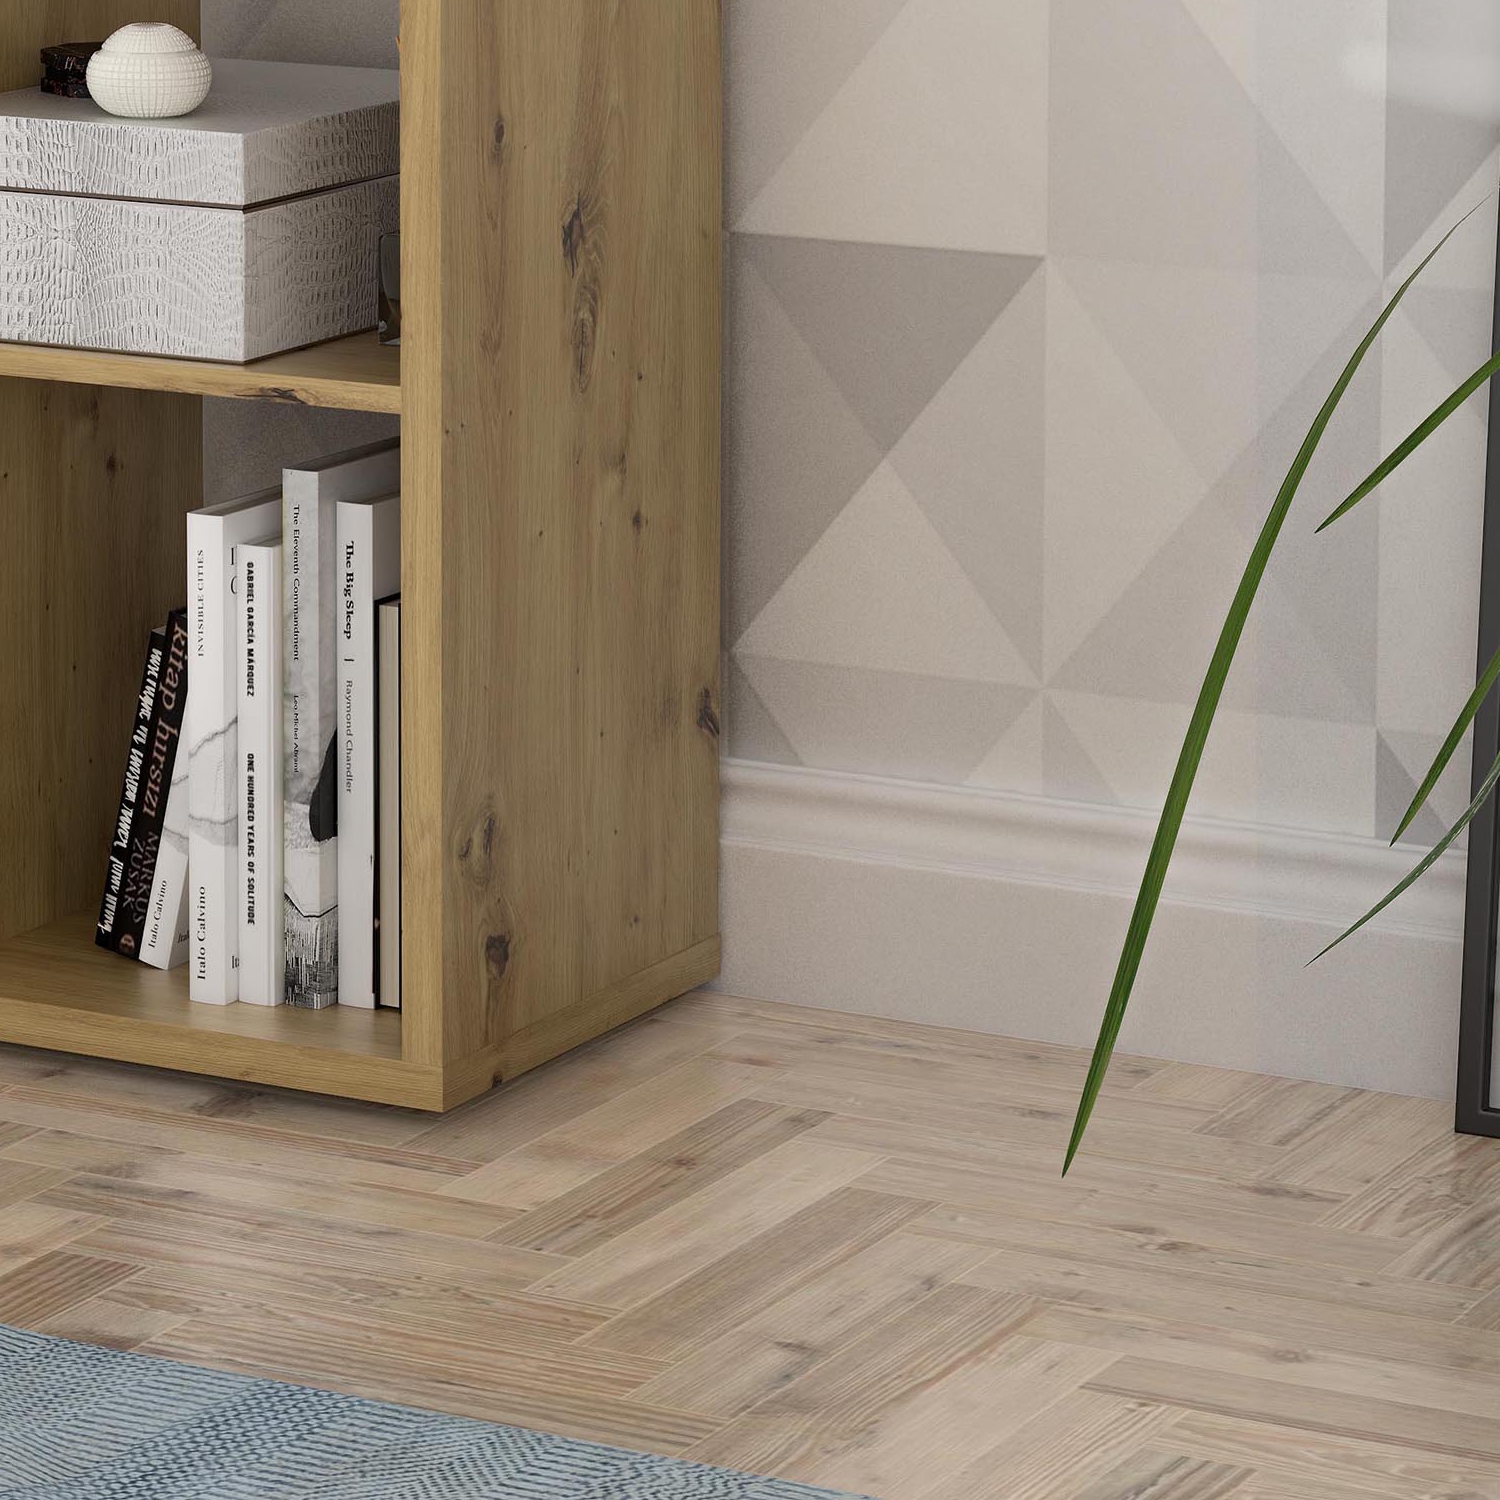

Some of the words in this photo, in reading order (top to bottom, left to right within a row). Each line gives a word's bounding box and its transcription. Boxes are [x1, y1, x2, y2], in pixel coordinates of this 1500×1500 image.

[293, 503, 301, 526] The
[293, 528, 301, 575] Eleventh
[345, 540, 355, 569] The
[246, 561, 255, 605] GABRIEL
[343, 571, 355, 598] Big
[197, 594, 205, 657] INVISIBLE
[246, 606, 256, 645] GARCÍA
[293, 577, 301, 661] Commandment
[343, 599, 355, 640] Sleep
[158, 621, 188, 711] kitap
[246, 647, 256, 698] MÁRQUEZ
[344, 679, 354, 737] Raymond
[246, 752, 255, 773] ONE
[345, 739, 354, 794] Chandler
[246, 775, 255, 823] HUNDRED
[246, 825, 256, 858] YEARS
[122, 837, 147, 910] ZUSAK
[132, 831, 160, 924] MARKUS
[247, 860, 256, 875] OF
[153, 879, 168, 921] Calvino
[197, 885, 206, 942] Calvino
[247, 876, 256, 926] SOLITUDE
[148, 924, 160, 949] Italo
[197, 946, 206, 980] Italo
